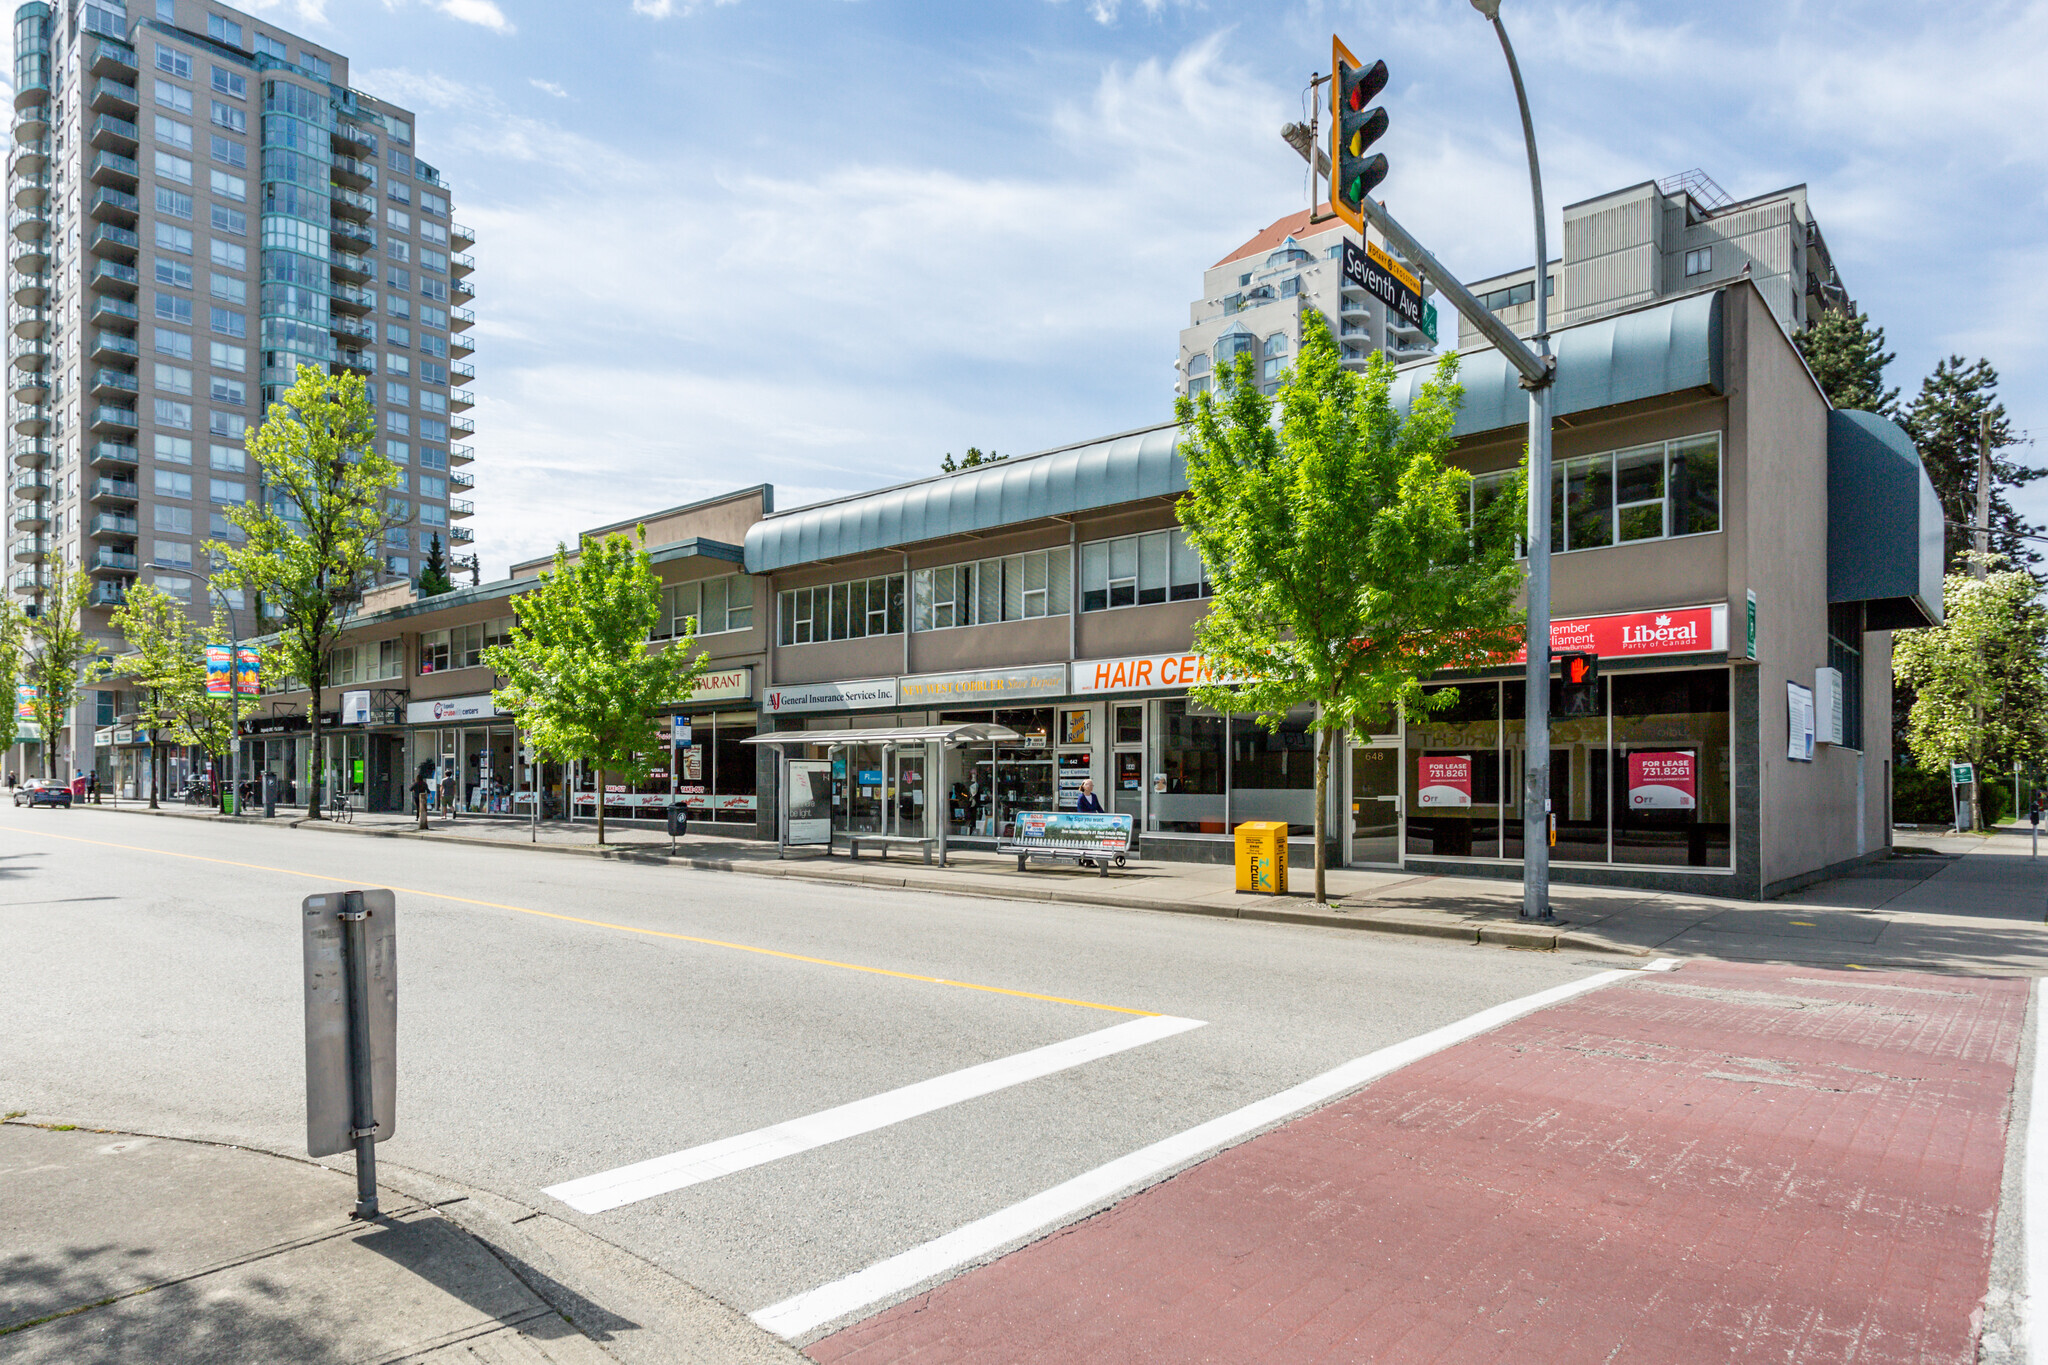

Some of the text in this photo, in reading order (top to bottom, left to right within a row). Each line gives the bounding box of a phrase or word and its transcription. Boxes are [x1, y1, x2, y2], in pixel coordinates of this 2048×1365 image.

[1347, 248, 1420, 324] Seventh Ave.
[1394, 264, 1420, 291] CROSSTOWN
[1550, 633, 1594, 646] liament
[1622, 621, 1697, 643] Liberal
[1622, 642, 1647, 650] Party
[1662, 638, 1696, 647] Canada
[1094, 660, 1153, 690] HAIR
[902, 676, 1061, 696] NEW WEST COBBLER Shoe Repair
[781, 694, 807, 706] General
[809, 693, 844, 704] Insurance
[845, 691, 876, 701] Services
[878, 688, 892, 698] Inc.
[1069, 714, 1085, 727] Shoe
[1067, 722, 1090, 742] Repair
[1365, 752, 1384, 761] 648
[1430, 769, 1467, 778] 731.8261
[1642, 767, 1690, 776] 731.8261
[681, 785, 704, 794] TAKE-OUT
[1250, 856, 1259, 891] FREE
